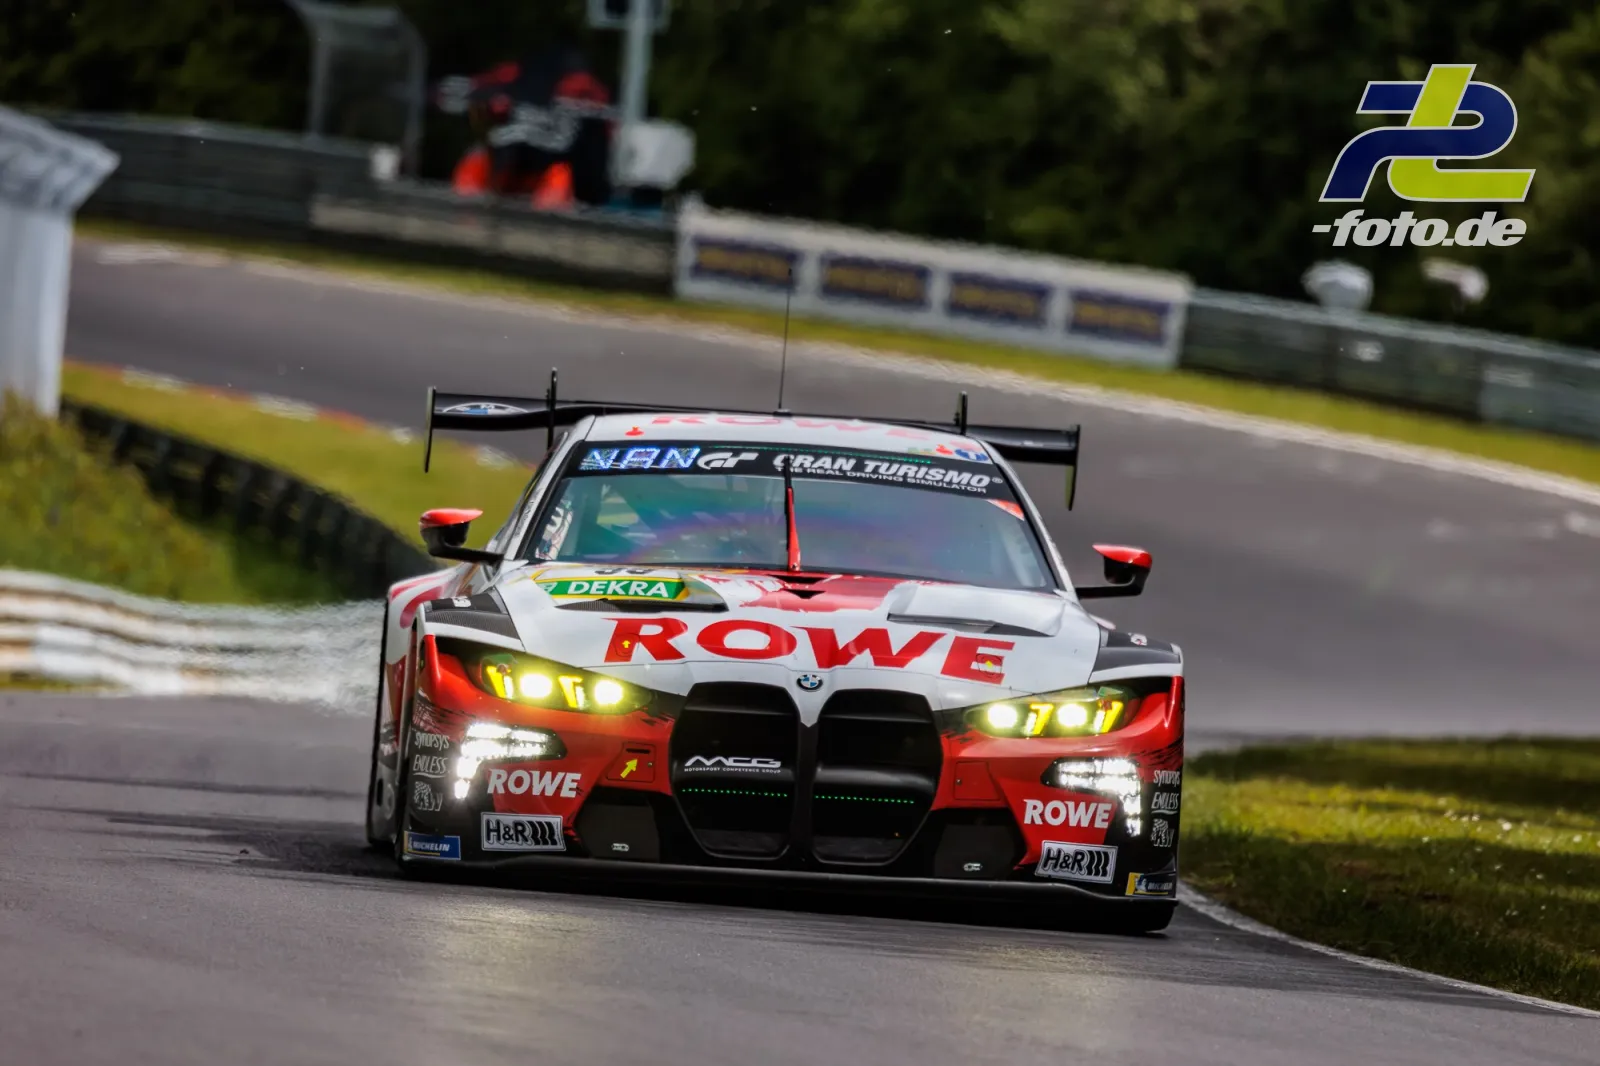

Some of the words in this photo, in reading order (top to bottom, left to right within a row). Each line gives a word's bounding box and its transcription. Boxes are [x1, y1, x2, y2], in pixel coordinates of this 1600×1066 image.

[773, 453, 856, 473] GRAN
[806, 468, 844, 476] REAL
[846, 471, 904, 482] DRIVING
[907, 477, 987, 493] SIMULATOR
[567, 581, 669, 598] DEKRA
[602, 616, 1016, 685] ROWE
[487, 768, 581, 798] ROWE
[1023, 799, 1112, 829] ROWE
